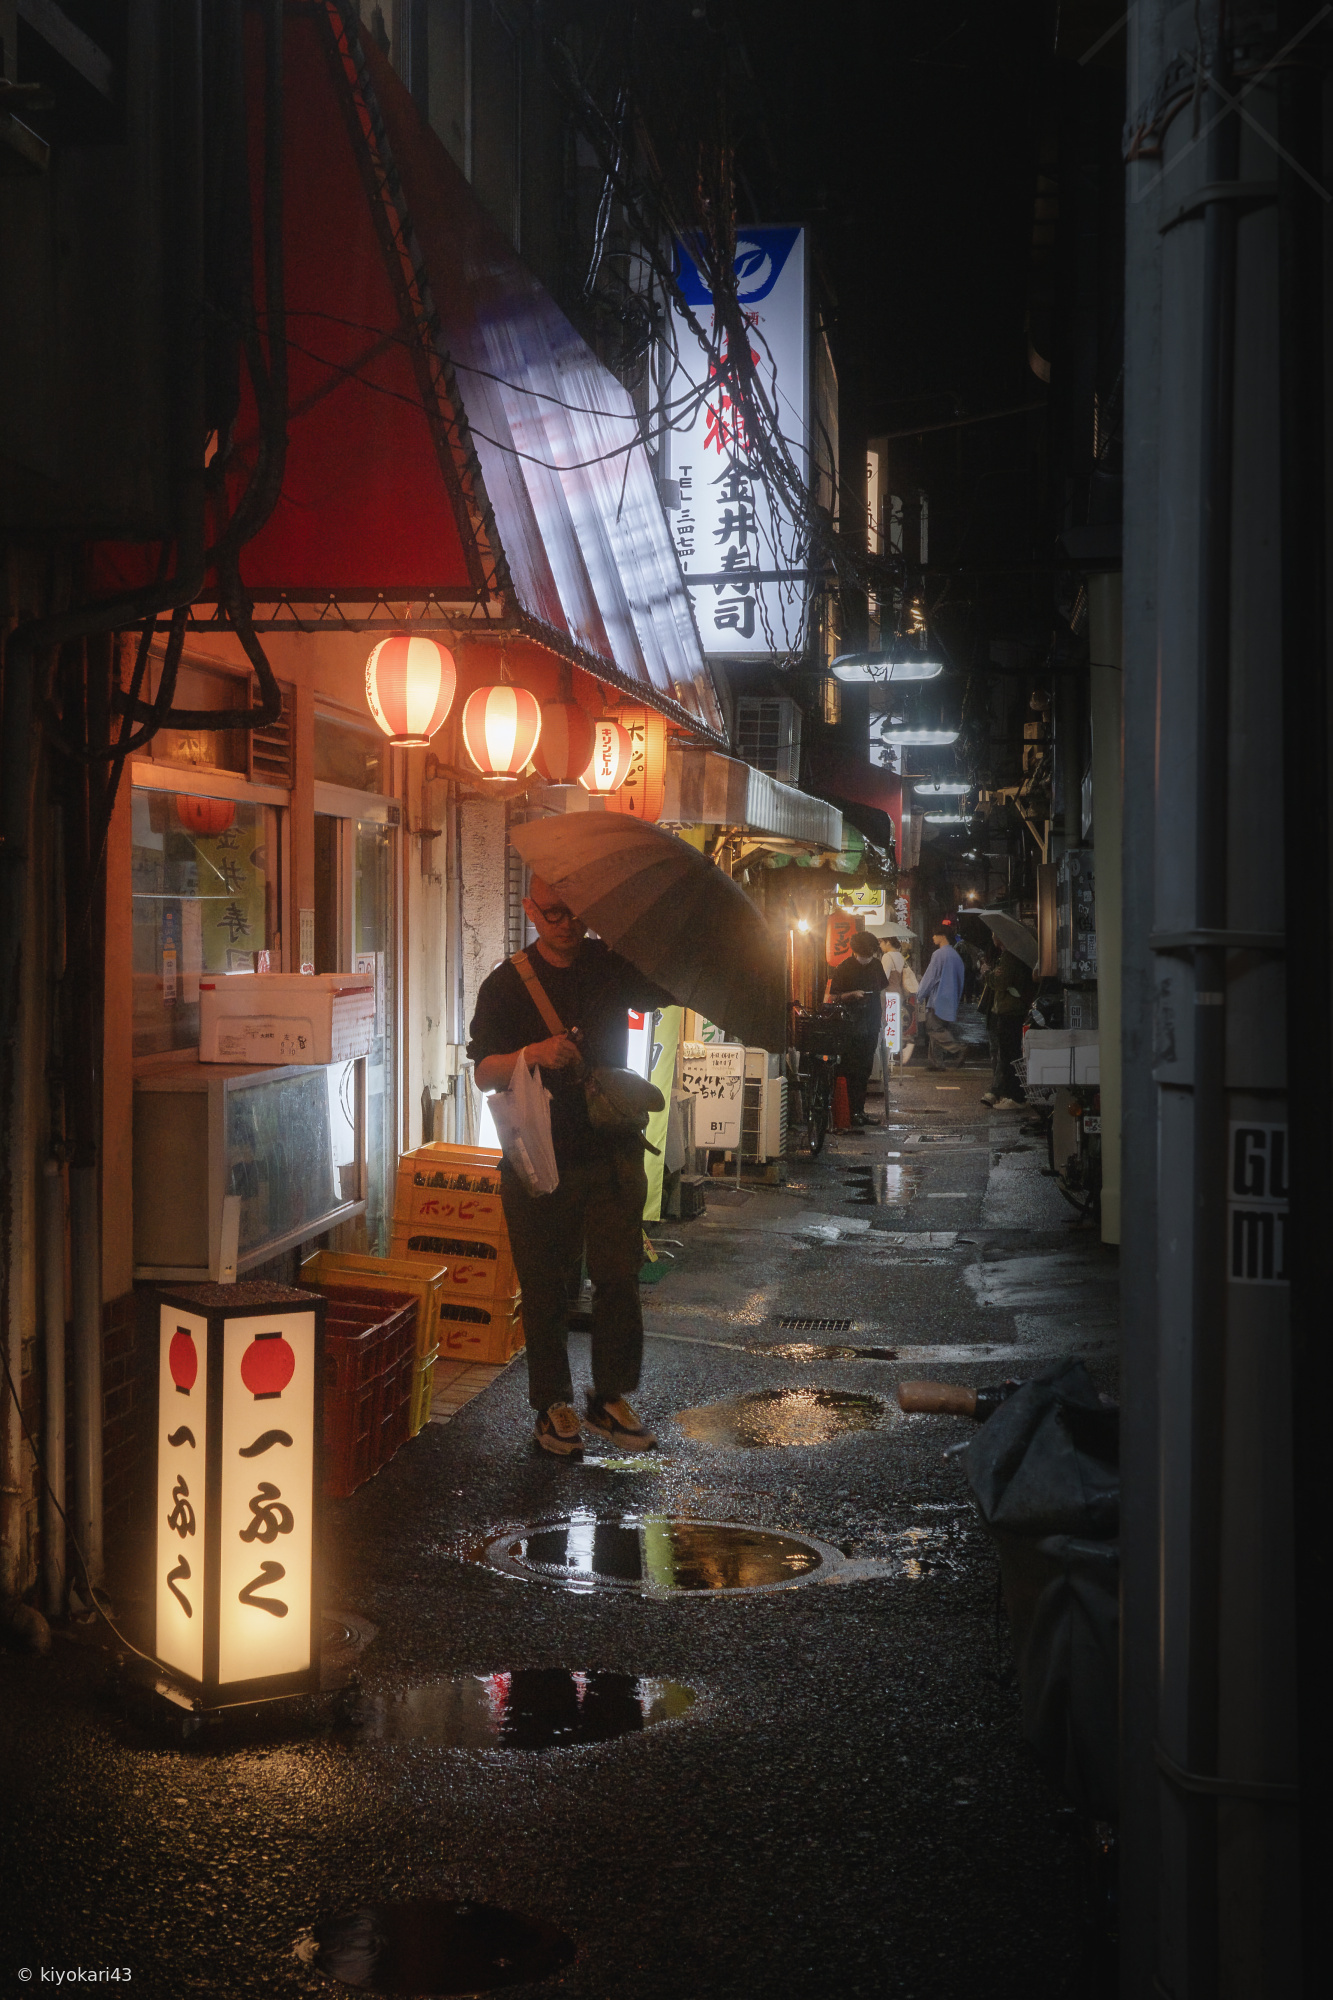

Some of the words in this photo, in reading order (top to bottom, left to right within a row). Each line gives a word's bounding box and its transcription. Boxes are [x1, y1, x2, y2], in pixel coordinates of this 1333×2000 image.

[679, 465, 693, 501] TEL
[707, 460, 760, 639] 金井寿司
[602, 728, 612, 776] キリンビール
[834, 922, 851, 956] ラーメン
[886, 998, 896, 1036] 炉ばた
[711, 1121, 723, 1131] B1
[419, 1200, 493, 1220] ホッピー
